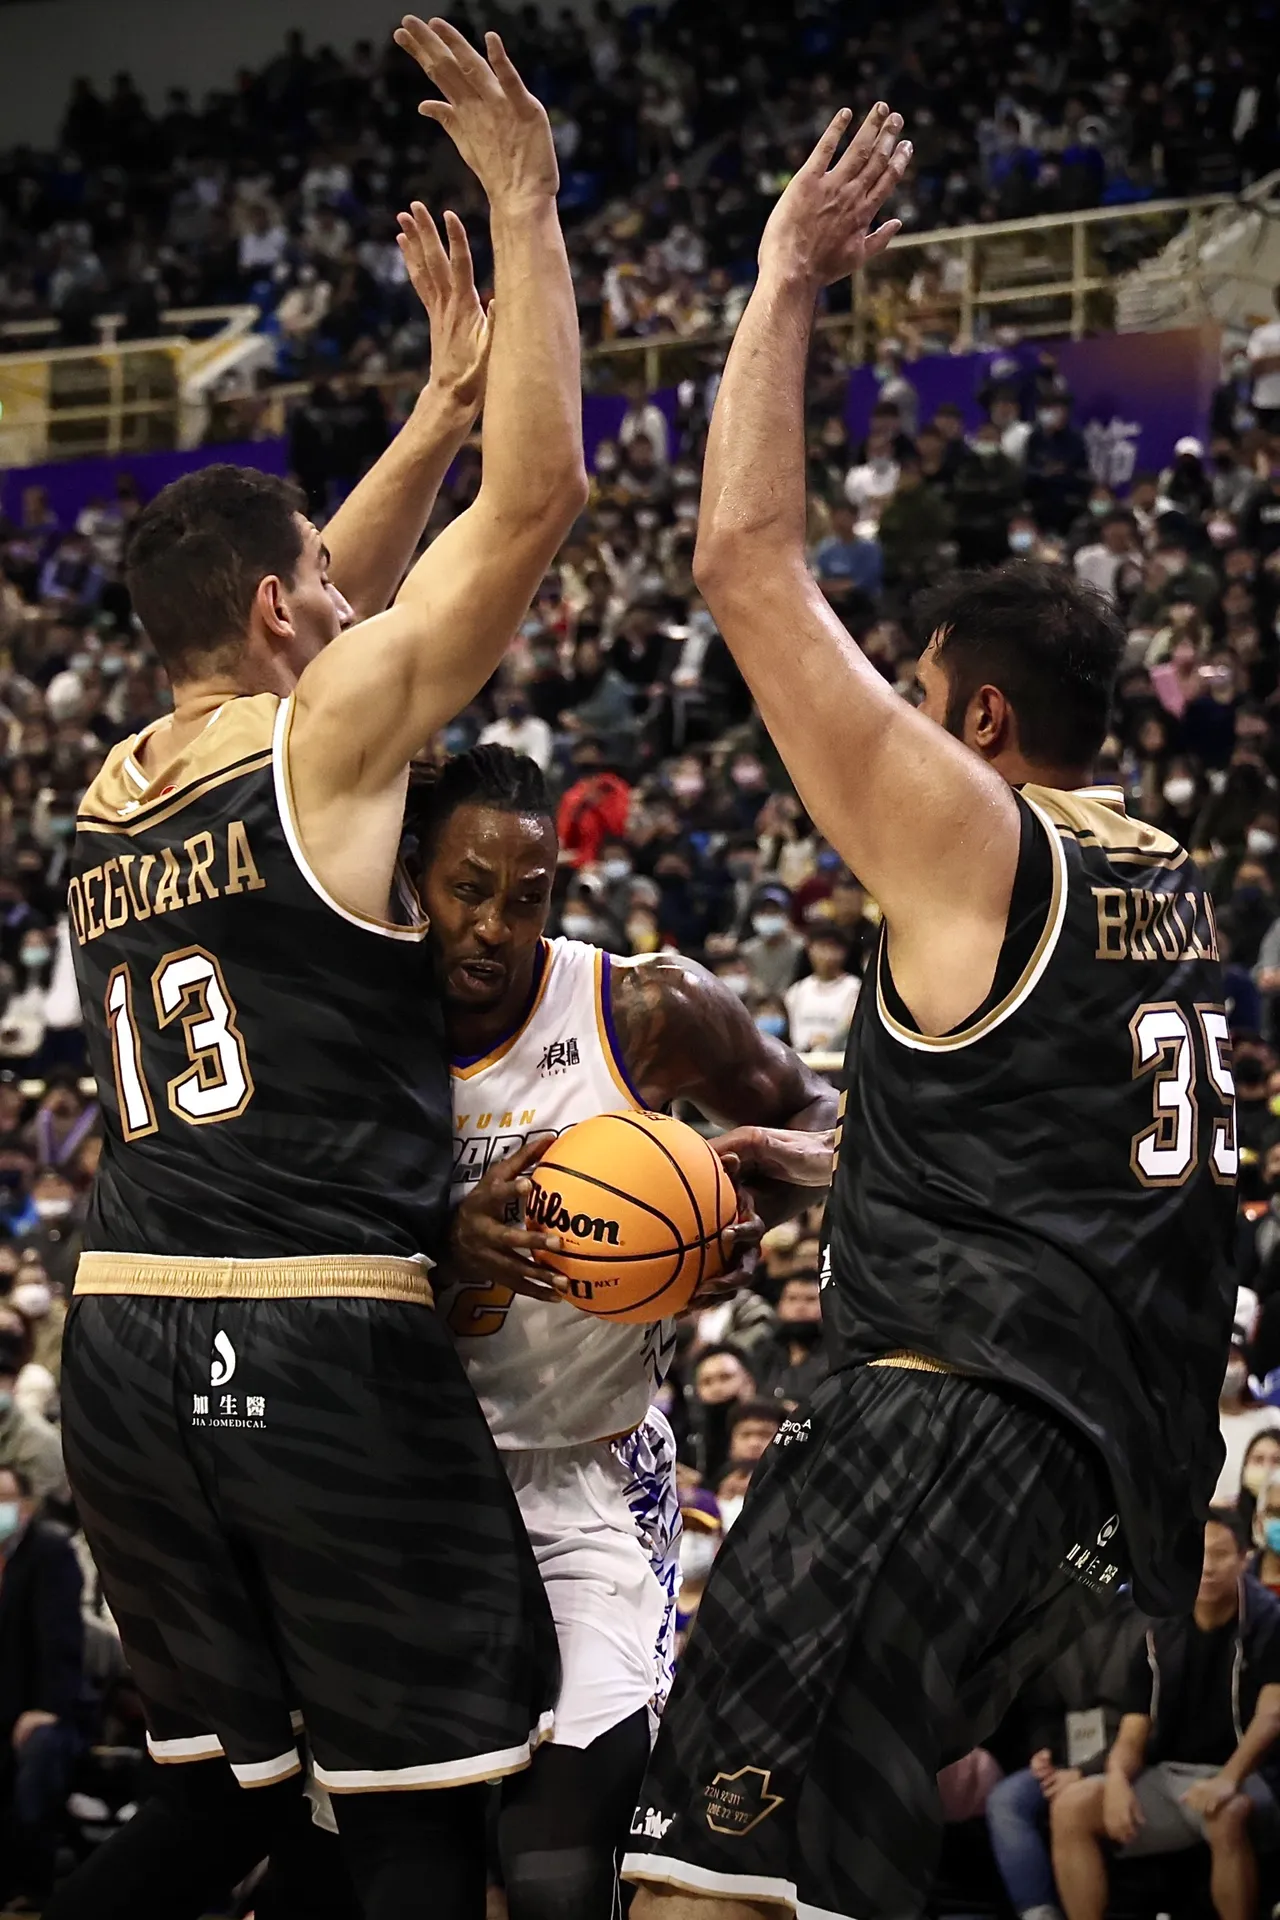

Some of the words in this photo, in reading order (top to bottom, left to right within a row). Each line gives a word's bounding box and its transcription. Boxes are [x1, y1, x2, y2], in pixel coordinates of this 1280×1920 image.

[67, 820, 267, 946] DEGUARA
[104, 944, 255, 1143] 13
[456, 1109, 536, 1130] YUAN
[1128, 1001, 1239, 1187] 35
[594, 1277, 620, 1288] NXT
[191, 1417, 206, 1426] JIA
